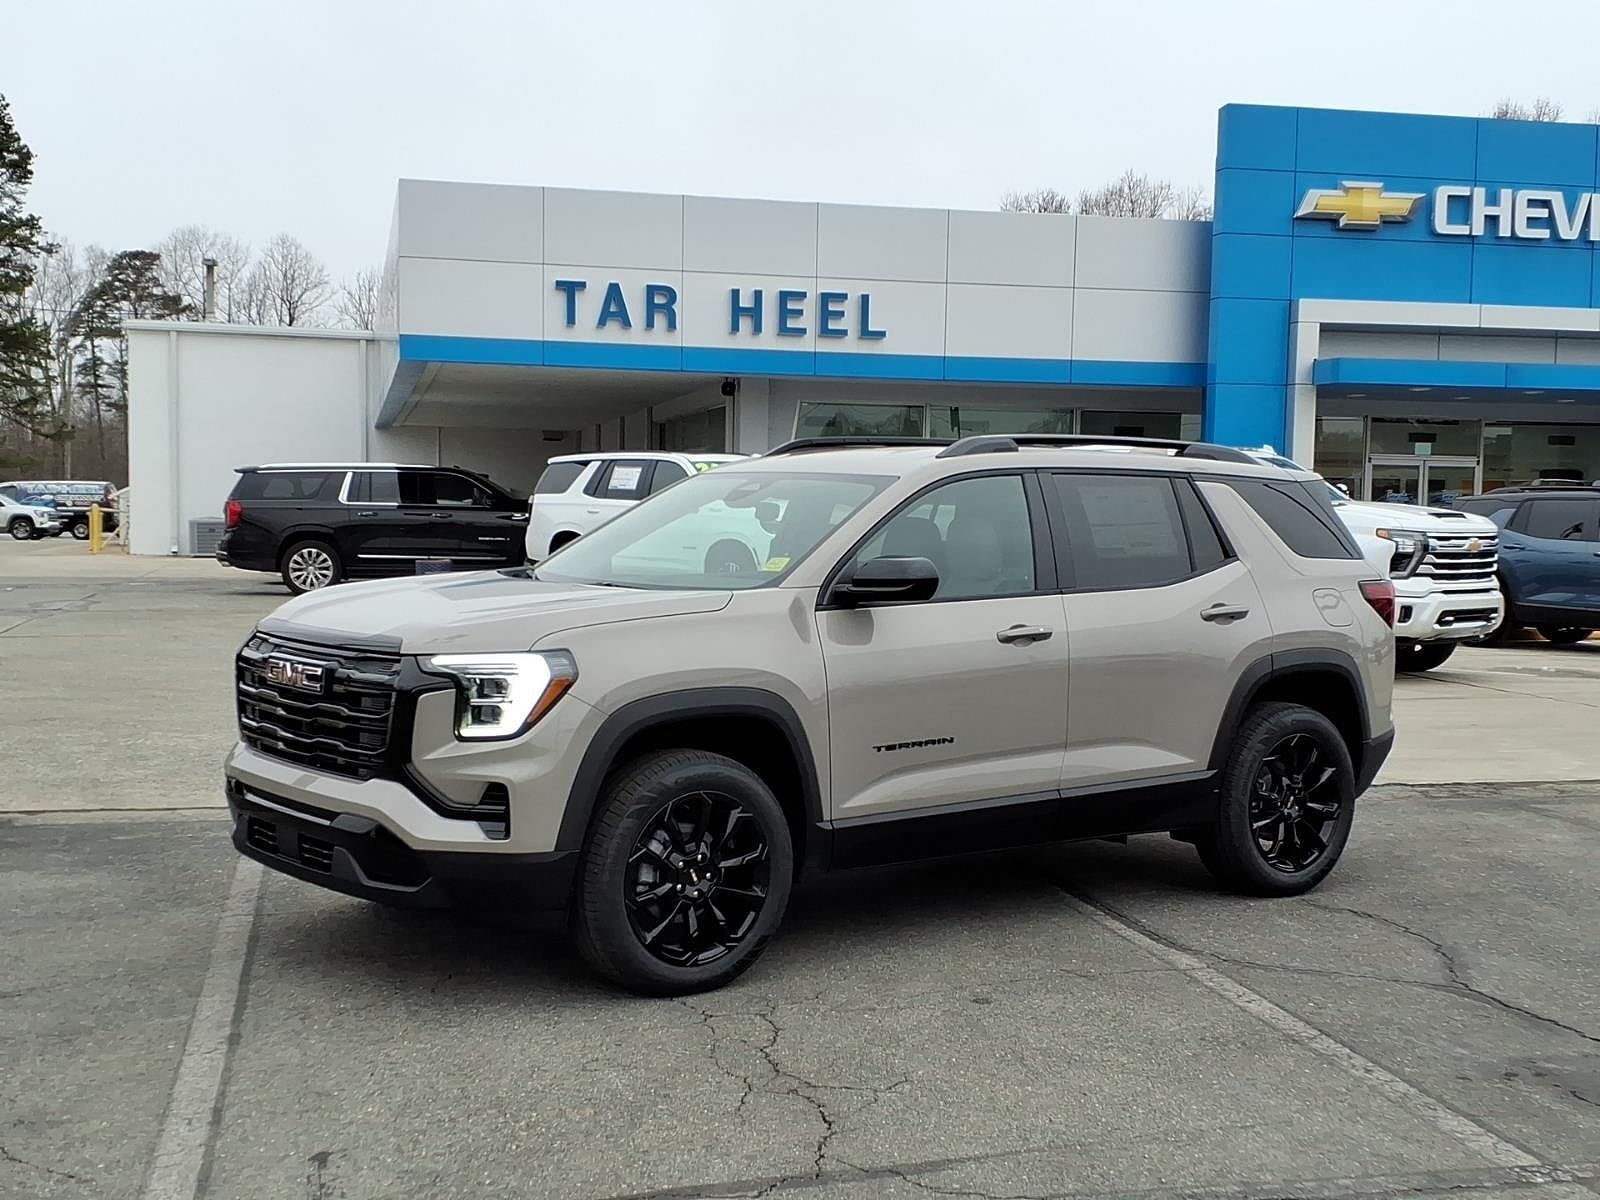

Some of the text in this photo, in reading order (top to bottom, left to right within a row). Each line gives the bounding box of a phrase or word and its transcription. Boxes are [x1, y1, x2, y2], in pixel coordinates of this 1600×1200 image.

[555, 279, 887, 340] TAR HEEL
[265, 659, 323, 692] GMC
[872, 736, 954, 753] TERRAIN
